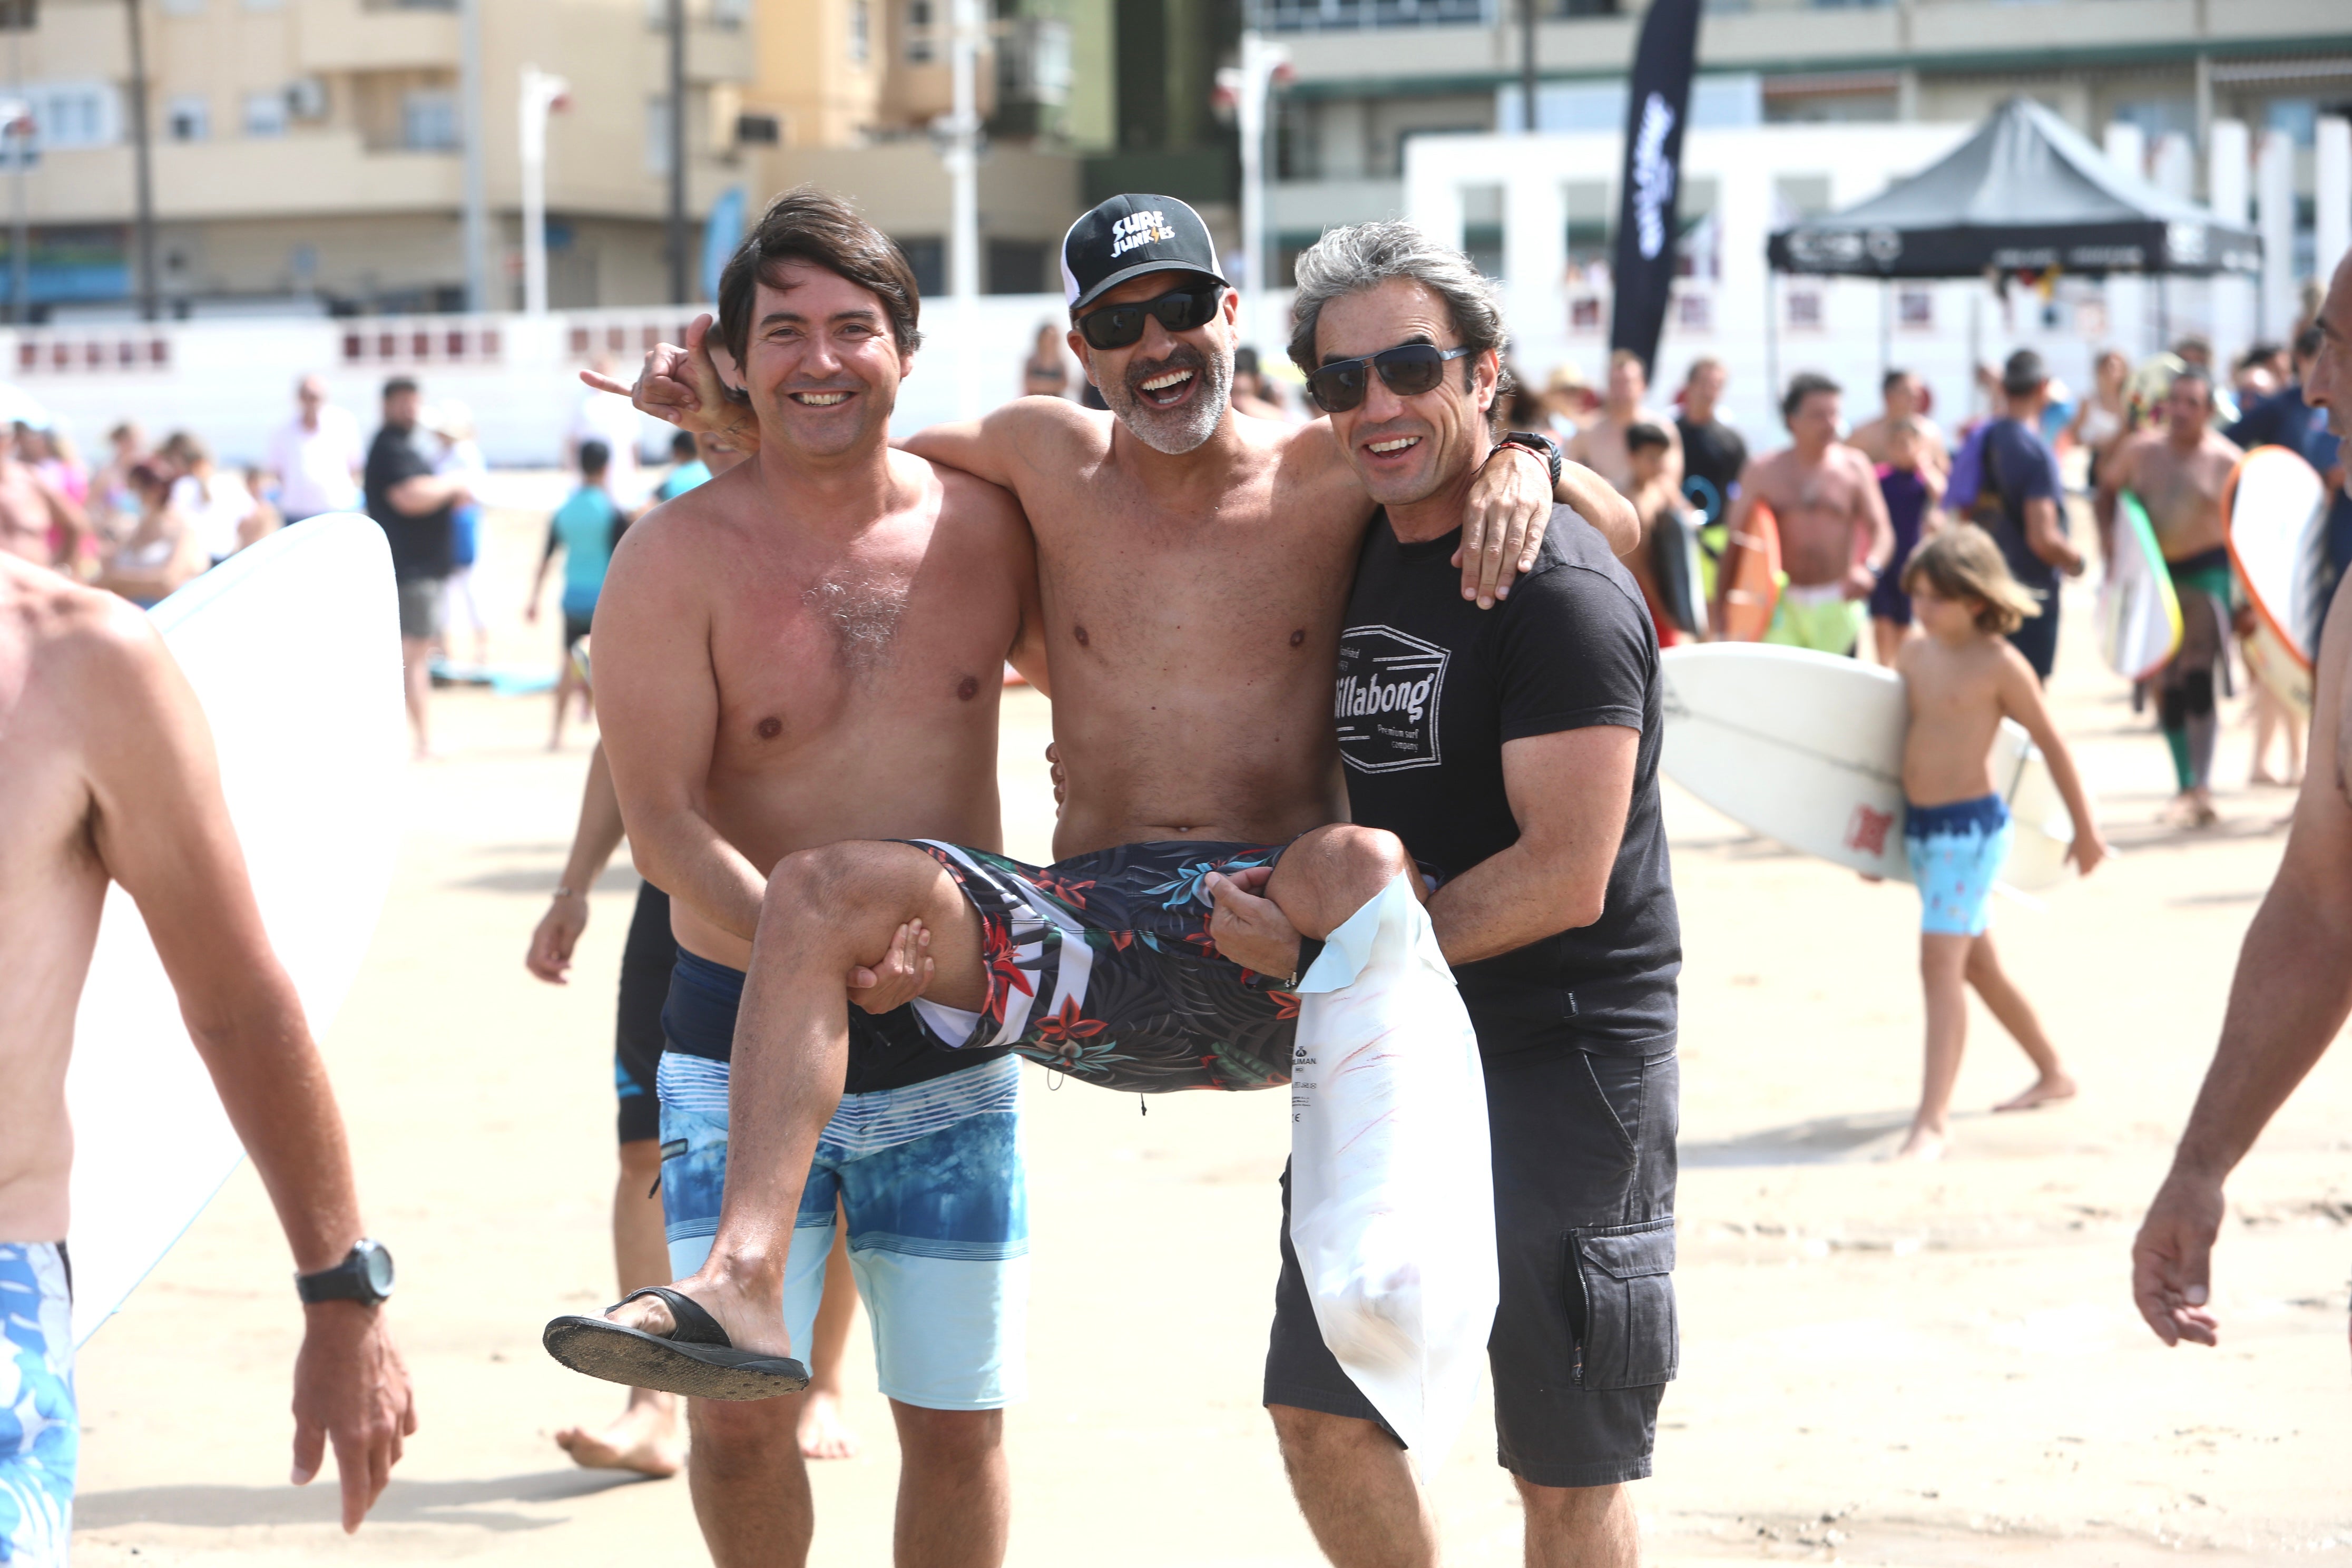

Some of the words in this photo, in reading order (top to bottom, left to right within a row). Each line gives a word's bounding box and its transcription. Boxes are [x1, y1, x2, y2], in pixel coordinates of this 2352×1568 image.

[1112, 211, 1164, 242] SURF
[1335, 673, 1435, 724] illabong
[1377, 724, 1404, 738] Premium
[1405, 729, 1419, 739] surf
